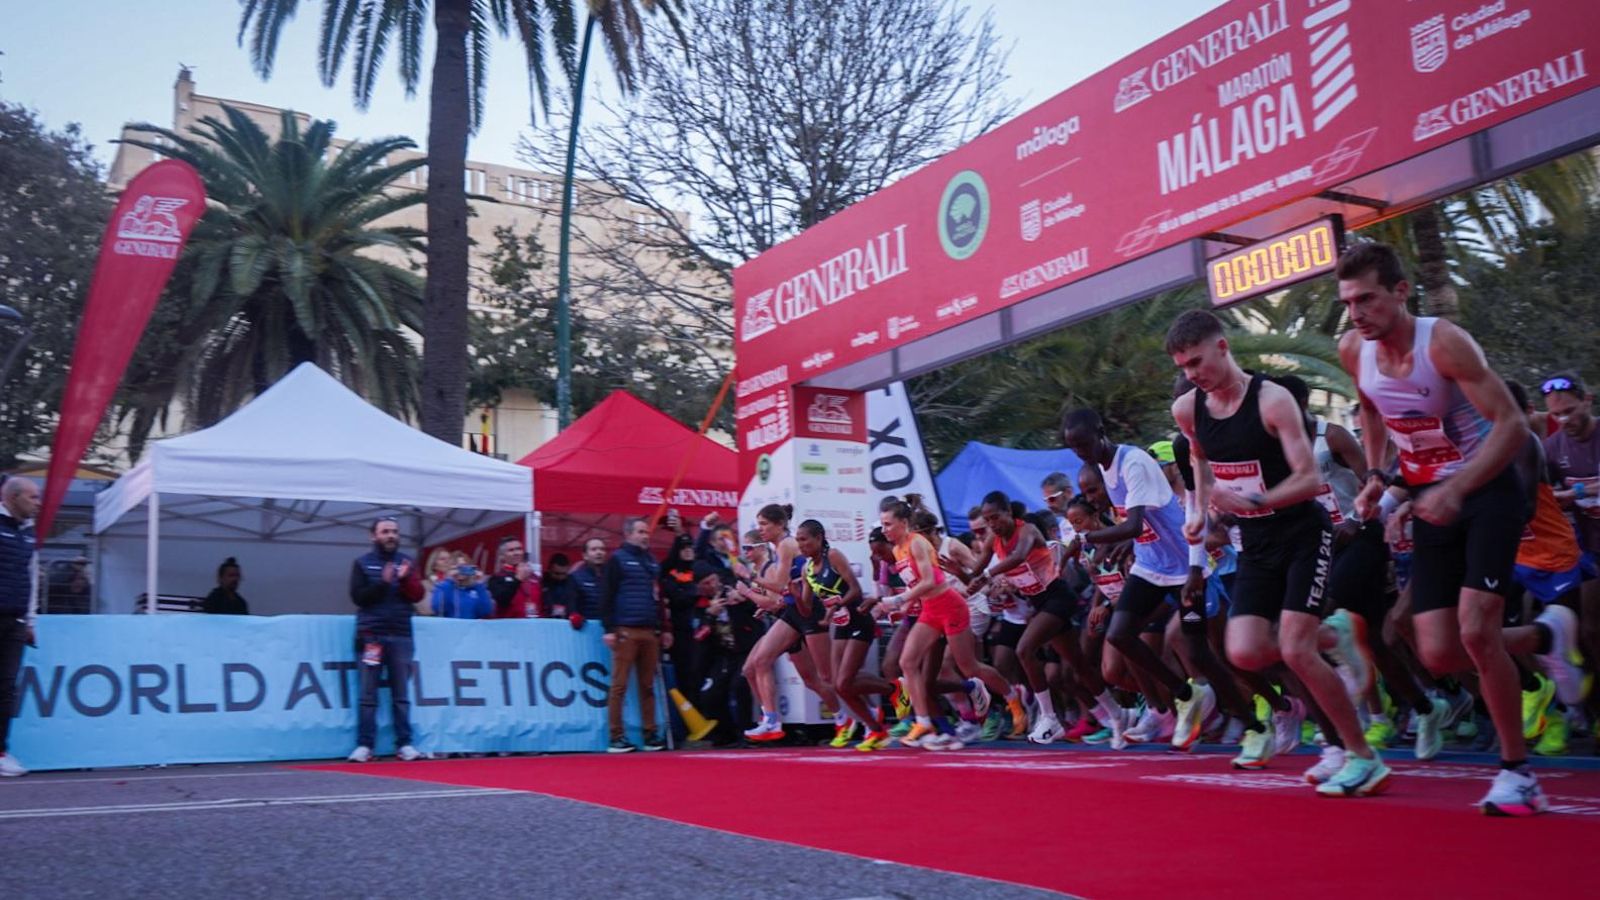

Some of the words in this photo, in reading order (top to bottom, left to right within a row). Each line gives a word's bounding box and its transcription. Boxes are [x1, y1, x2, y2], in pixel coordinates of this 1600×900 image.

[1451, 0, 1506, 31] Ciudad
[1453, 34, 1475, 50] de
[1474, 9, 1532, 41] Málaga
[1150, 0, 1290, 94] GENERALI
[1217, 52, 1293, 108] MARATÓN
[1450, 49, 1588, 126] GENERALI
[1016, 115, 1081, 161] málaga
[1157, 82, 1306, 195] MÁLAGA
[774, 224, 911, 326] GENERALI
[1018, 247, 1090, 291] GENERALI
[1306, 558, 1329, 609] TEAM
[12, 662, 267, 719] WORLD
